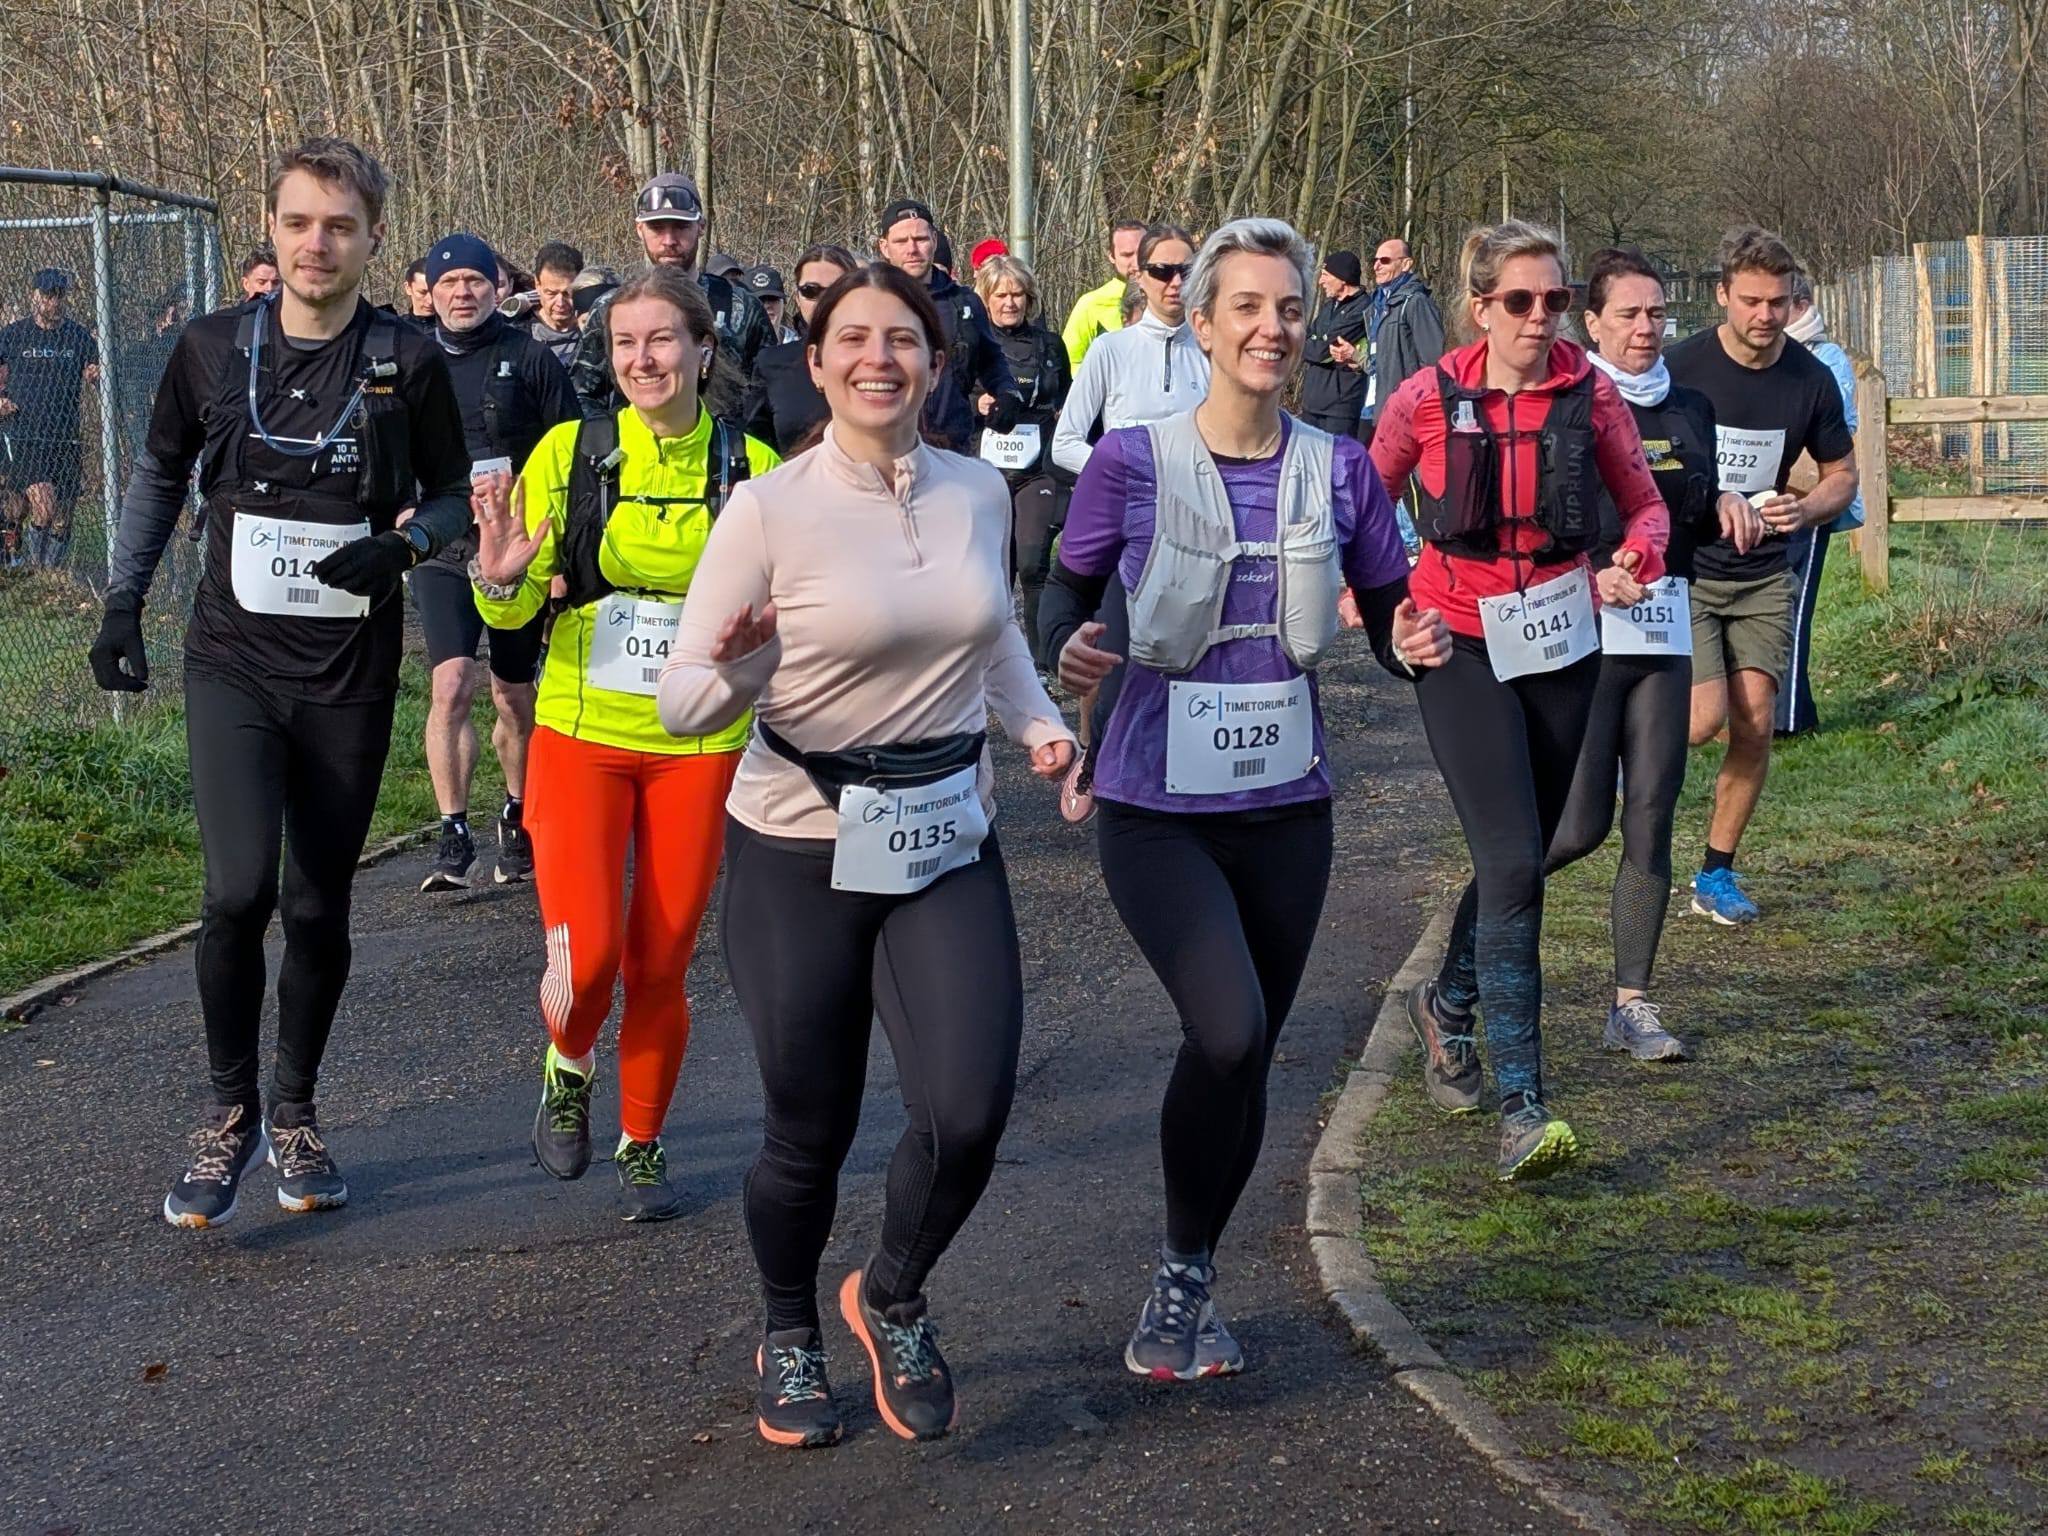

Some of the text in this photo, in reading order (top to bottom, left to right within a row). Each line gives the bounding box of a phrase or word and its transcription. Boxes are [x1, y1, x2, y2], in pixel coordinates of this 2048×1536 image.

[336, 444, 347, 453] 10
[996, 440, 1024, 451] 0200
[1716, 452, 1757, 468] 0232
[1565, 443, 1584, 529] KIPRUN
[1236, 570, 1274, 585] zeker!
[1631, 606, 1674, 623] 0151
[1523, 610, 1573, 641] 0141
[626, 636, 675, 659] 014
[1224, 695, 1299, 712] TIMETORUN.BE
[1213, 723, 1280, 751] 0128
[904, 786, 971, 816] TIMETORUN.BE
[888, 820, 956, 853] 0135
